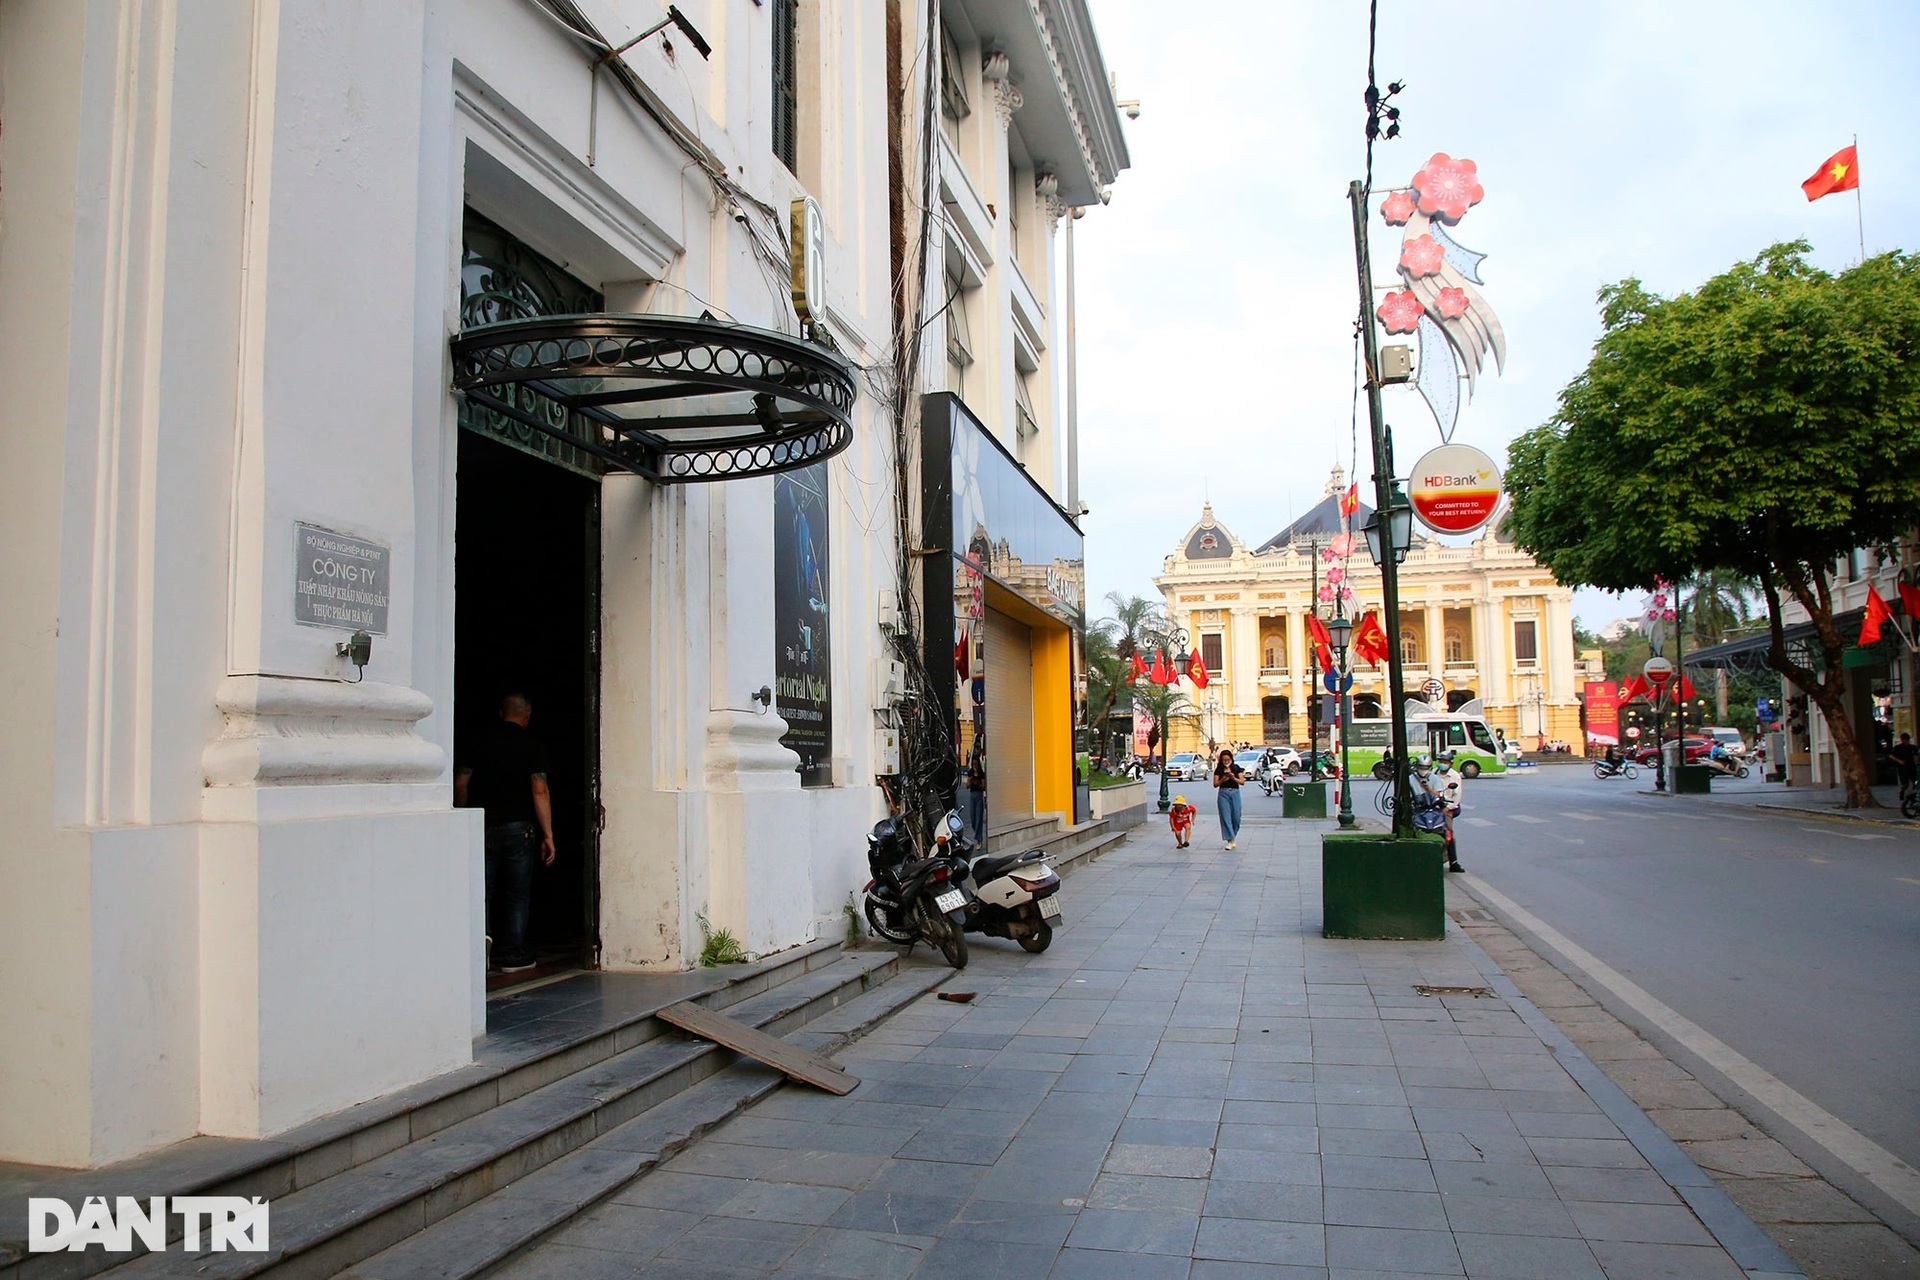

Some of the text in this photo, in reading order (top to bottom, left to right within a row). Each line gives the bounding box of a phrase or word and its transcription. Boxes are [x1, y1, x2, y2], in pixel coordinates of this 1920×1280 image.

[1424, 475, 1477, 487] HDBank
[306, 536, 316, 547] BỘ
[317, 538, 335, 550] NÔNG
[361, 549, 365, 557] &
[366, 550, 381, 560] PTNT
[313, 558, 375, 584] CÔNG TY
[298, 578, 317, 596] XUẤT
[318, 583, 336, 600] NHẬP
[356, 589, 374, 605] NÔNG
[374, 591, 387, 607] SẢN
[313, 604, 332, 619] THỰC
[352, 610, 361, 622] HÀ
[362, 610, 374, 626] NỘI
[776, 672, 828, 708] artorial Night
